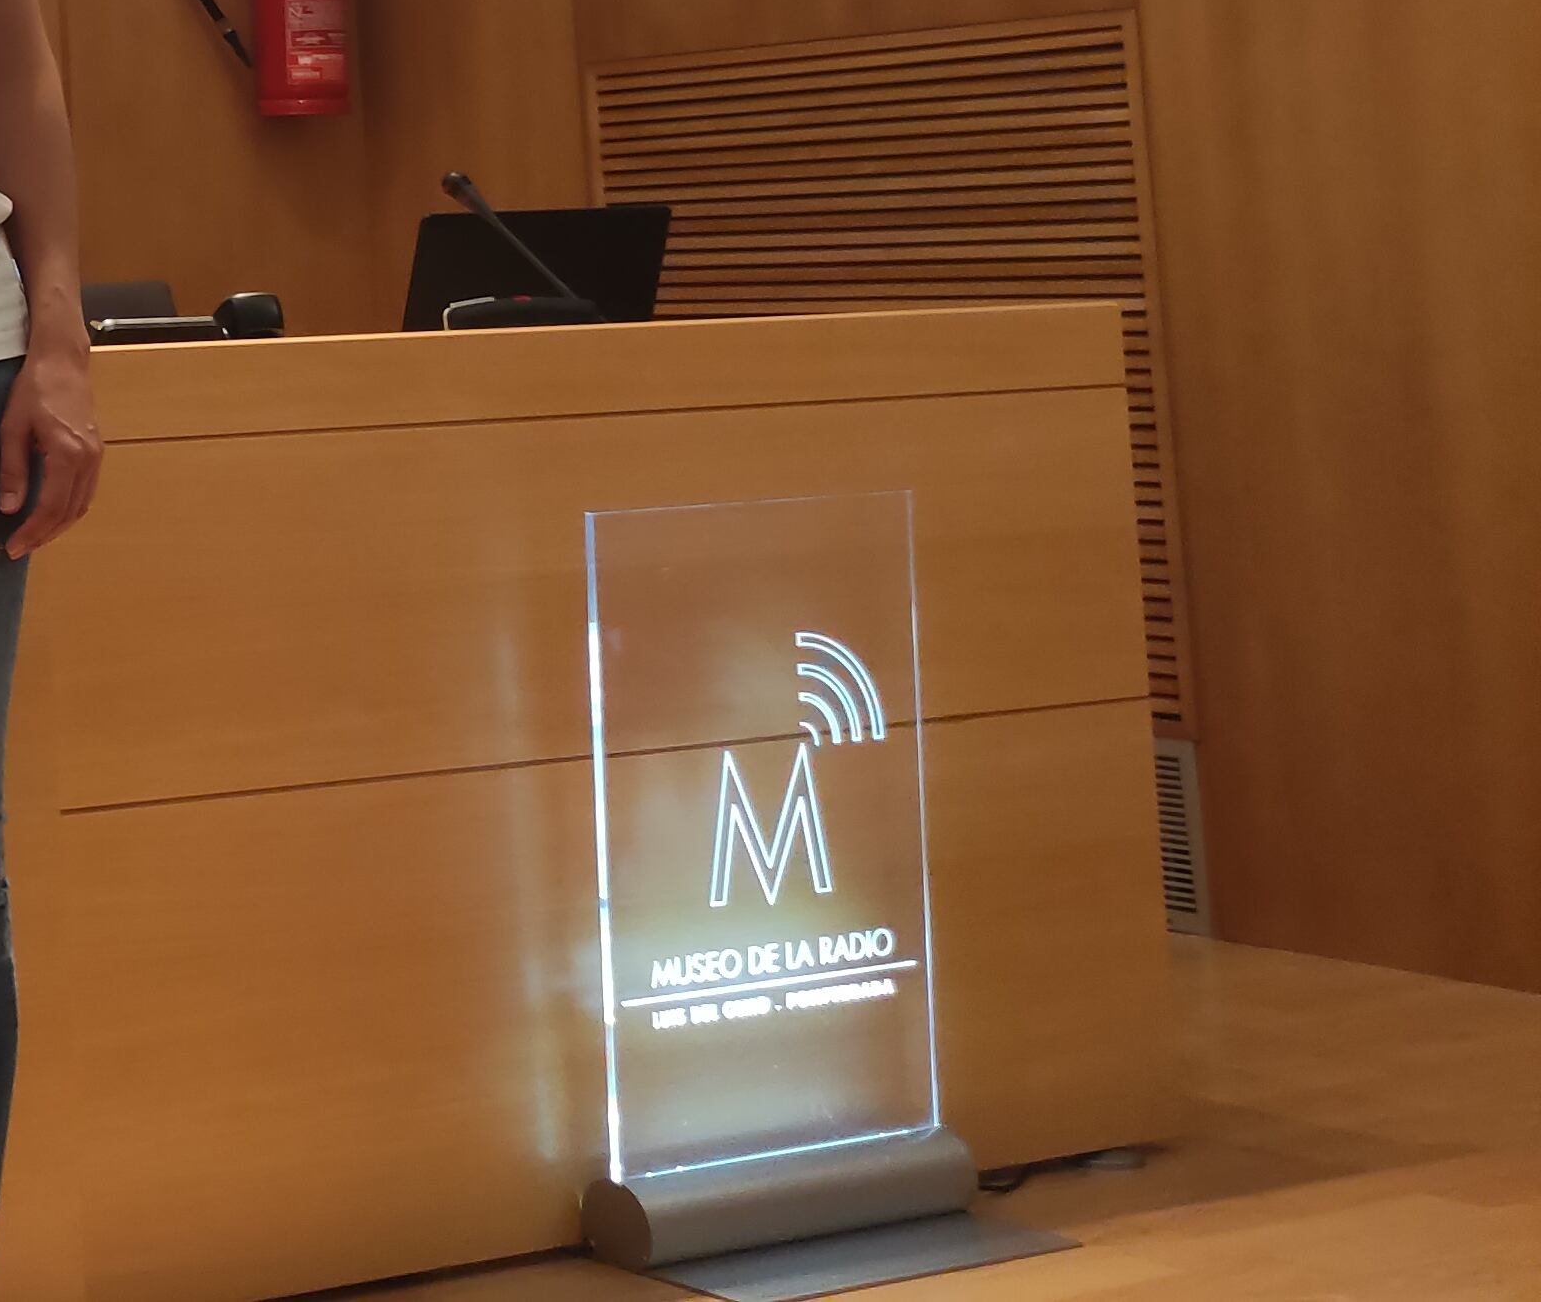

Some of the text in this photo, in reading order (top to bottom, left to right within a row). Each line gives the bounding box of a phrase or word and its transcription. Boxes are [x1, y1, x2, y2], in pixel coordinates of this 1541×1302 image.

[709, 741, 833, 907] M
[650, 927, 894, 988] MUSEO DE LA RADIO
